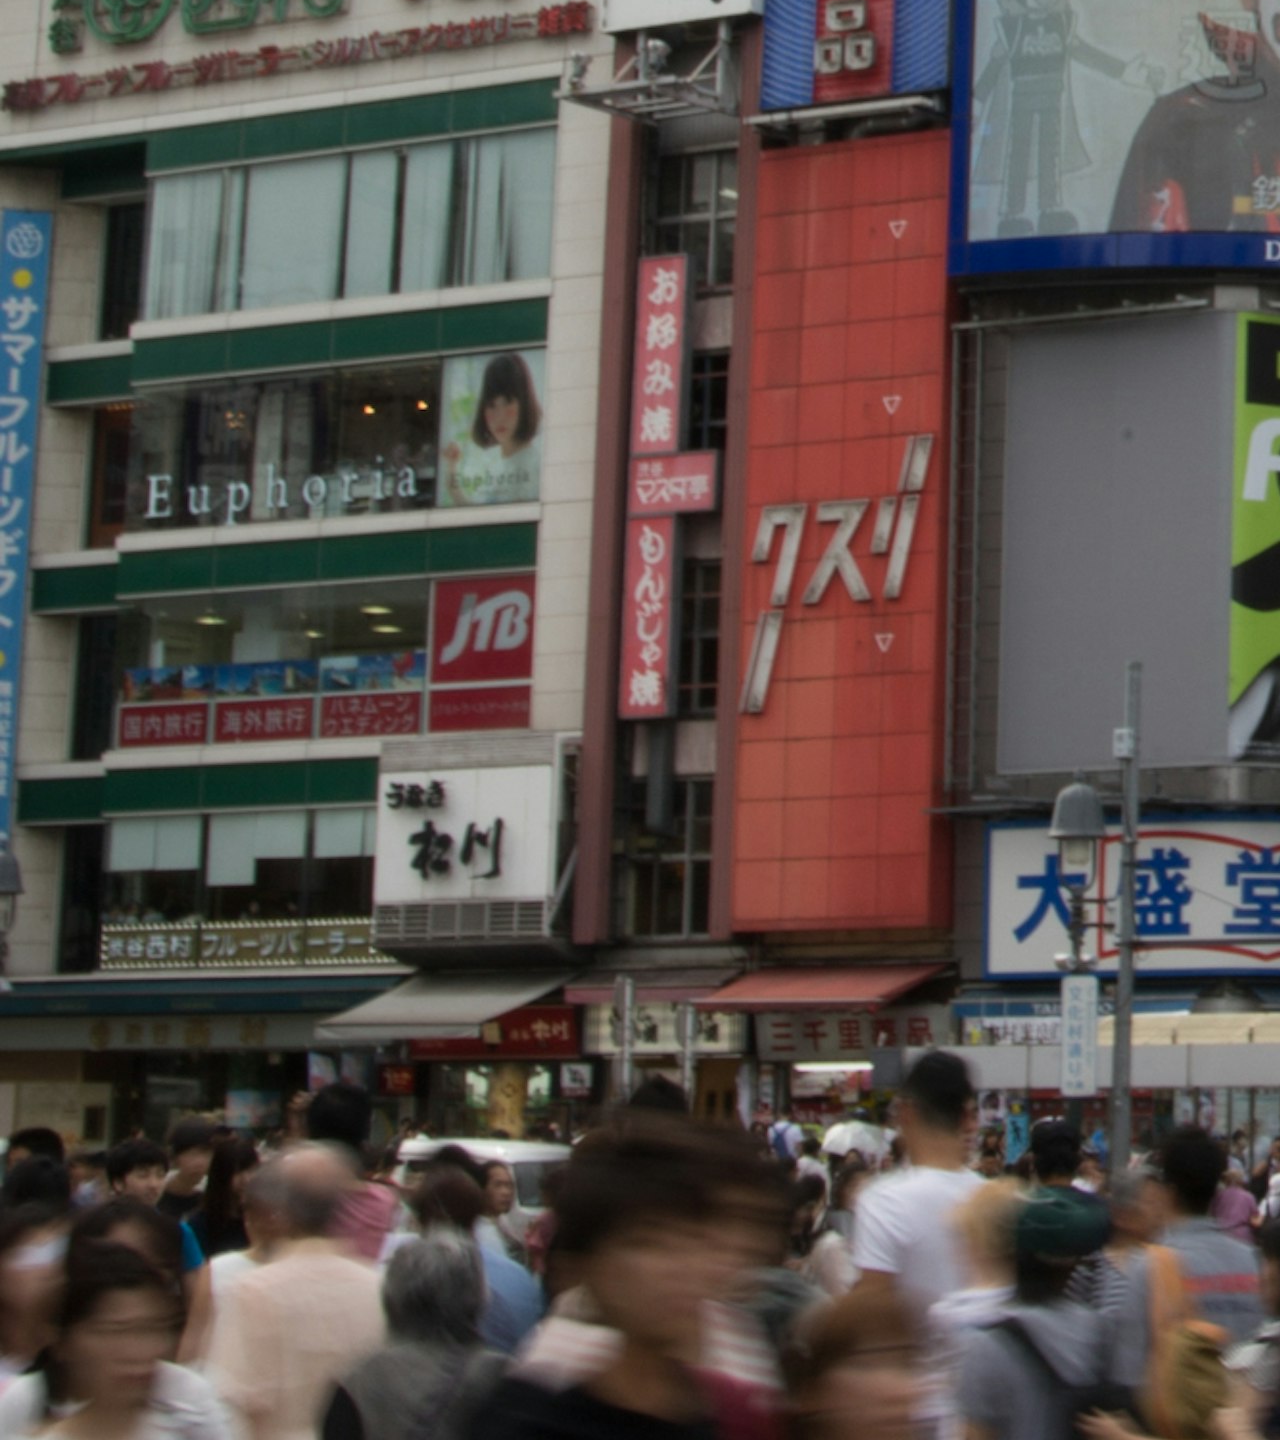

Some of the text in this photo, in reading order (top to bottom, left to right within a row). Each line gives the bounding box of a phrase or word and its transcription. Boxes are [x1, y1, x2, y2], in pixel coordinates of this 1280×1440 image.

[640, 267, 679, 444] お好み焼
[0, 296, 39, 628] サマーフルーツギフ
[145, 454, 420, 527] Euphoria
[440, 588, 533, 666] JTB
[628, 524, 666, 708] もんじゃ焼
[122, 711, 205, 740] 国内旅行
[221, 707, 307, 736] 海外旅行
[384, 779, 447, 810] うなぎ
[408, 816, 505, 881] 松川
[106, 933, 193, 960] 渋谷西村
